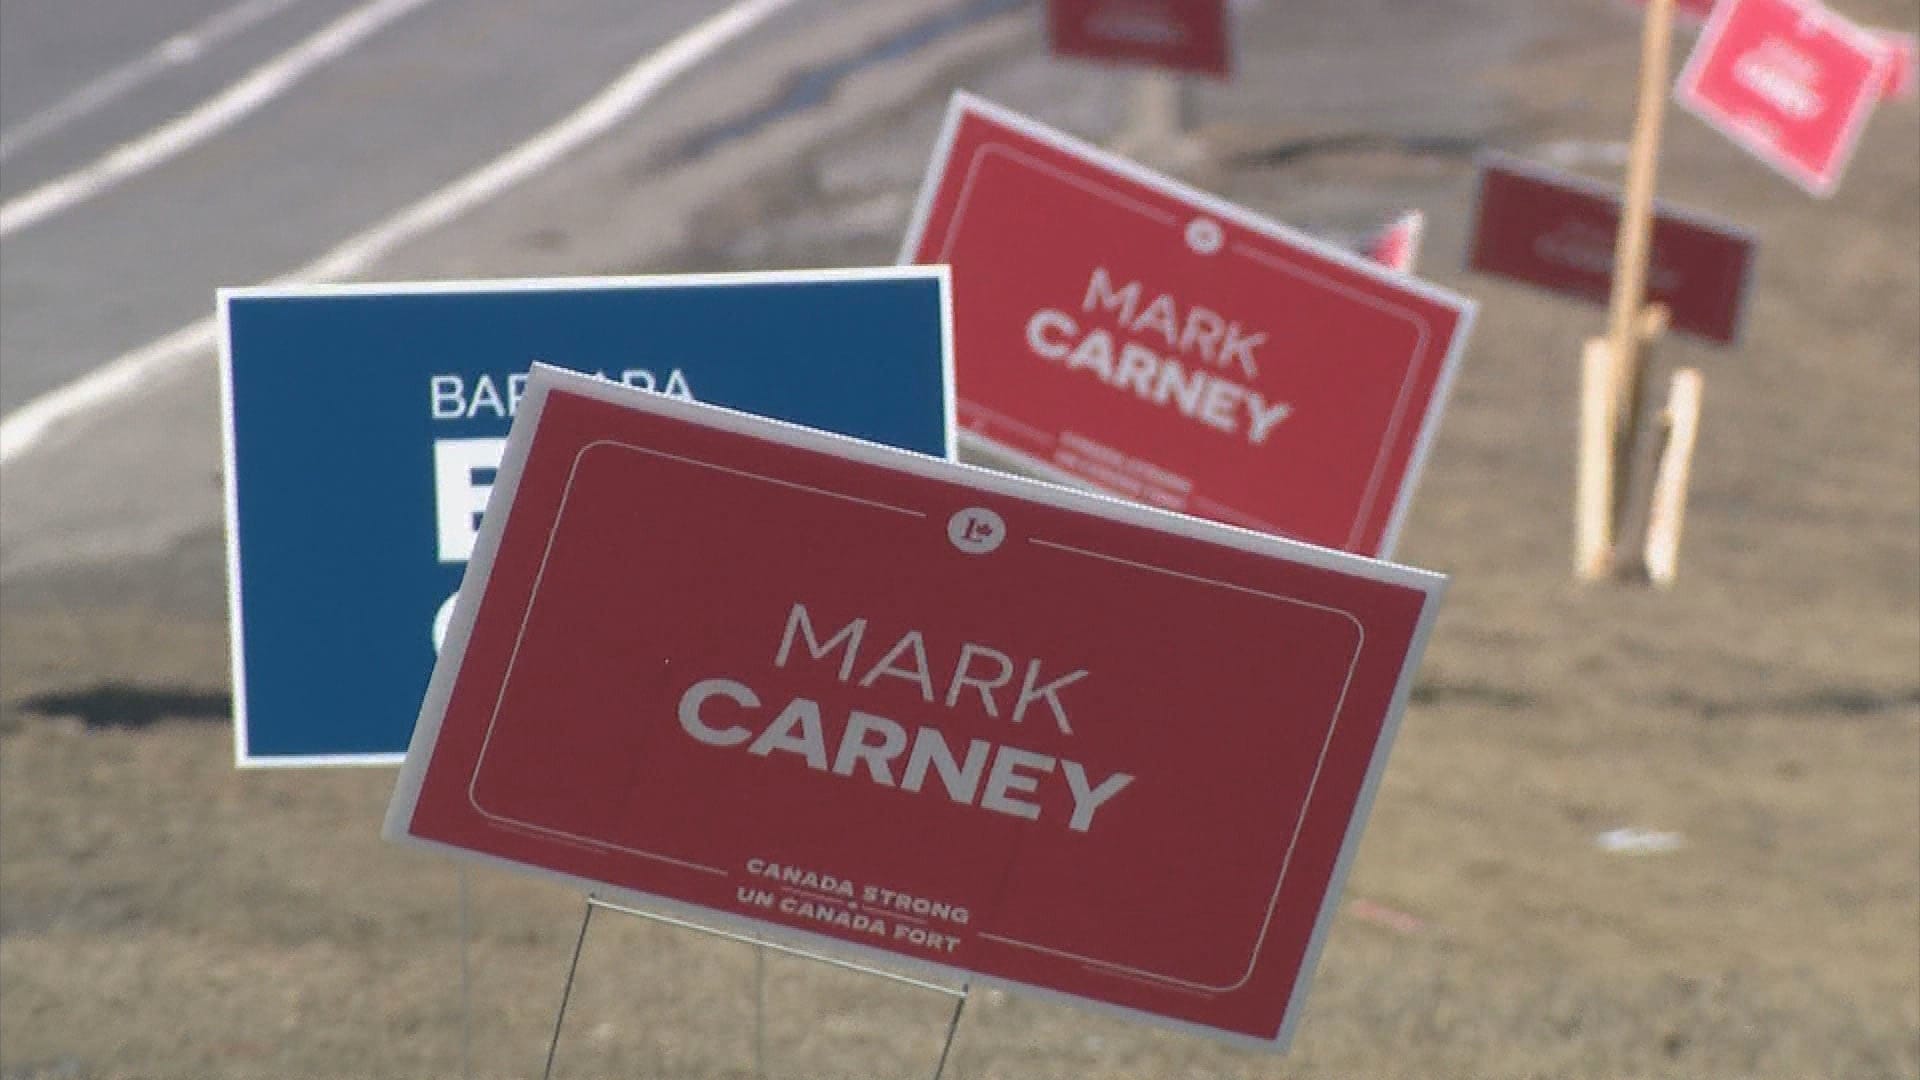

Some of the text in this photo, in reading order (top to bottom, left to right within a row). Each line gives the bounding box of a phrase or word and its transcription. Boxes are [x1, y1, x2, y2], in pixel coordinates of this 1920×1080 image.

[1025, 307, 1296, 447] CARNEY
[1082, 267, 1269, 378] MARK
[773, 602, 1090, 735] MARK
[677, 678, 1136, 833] CARNEY
[736, 886, 961, 953] UN CANADA FORT
[746, 858, 970, 924] CANADA STRONG
